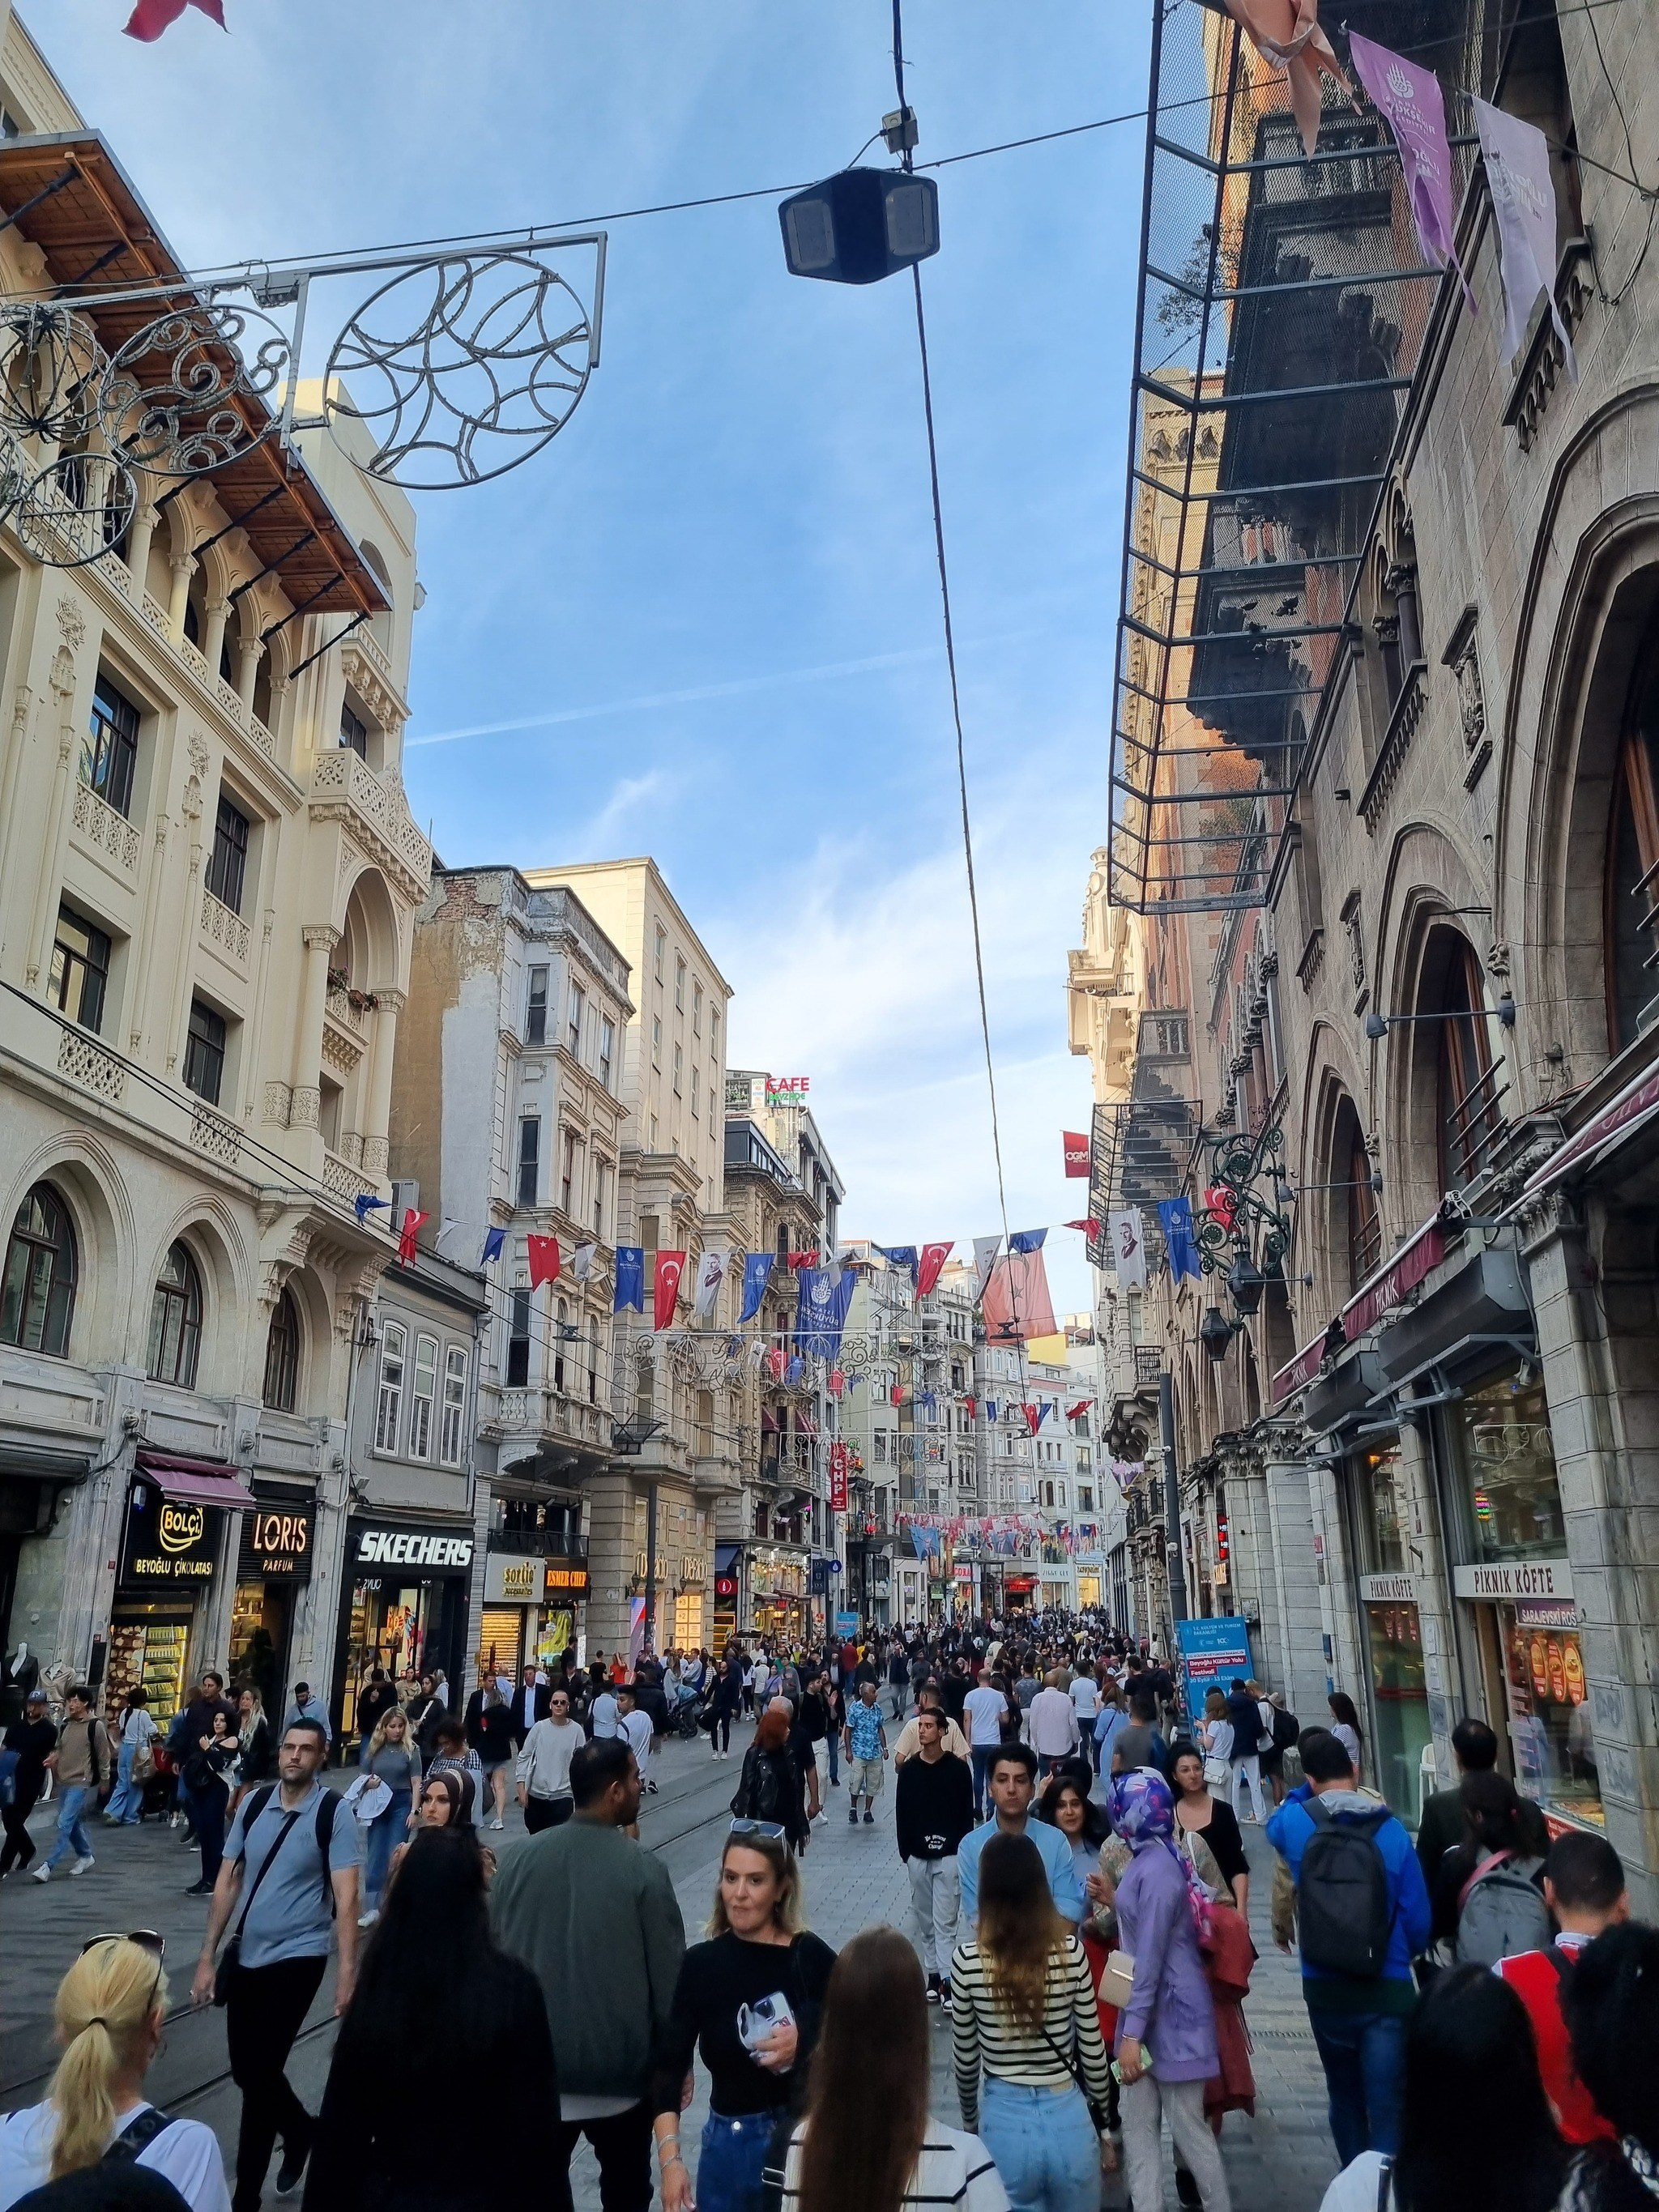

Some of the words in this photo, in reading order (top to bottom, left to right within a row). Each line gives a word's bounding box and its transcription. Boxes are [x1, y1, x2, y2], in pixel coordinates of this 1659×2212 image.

[766, 1077, 809, 1093] CAFE
[1065, 1150, 1089, 1161] OGM
[834, 1459, 844, 1495] CHP
[254, 1513, 307, 1553] LORIS
[357, 1531, 474, 1566] SKECHERS
[136, 1556, 172, 1575] BEYOĞLU
[174, 1557, 213, 1578] ÇİKOLATASI
[262, 1559, 293, 1571] PARFUM
[503, 1562, 535, 1585] sortie
[547, 1570, 569, 1587] ESMER
[569, 1571, 586, 1587] CHEF
[1370, 1576, 1391, 1598] PİKNİK
[1392, 1575, 1414, 1597] KÖFTE
[1473, 1566, 1512, 1594] PİKNİK
[1516, 1562, 1554, 1594] KÖFTE
[1189, 1659, 1213, 1668] Beyoğlu
